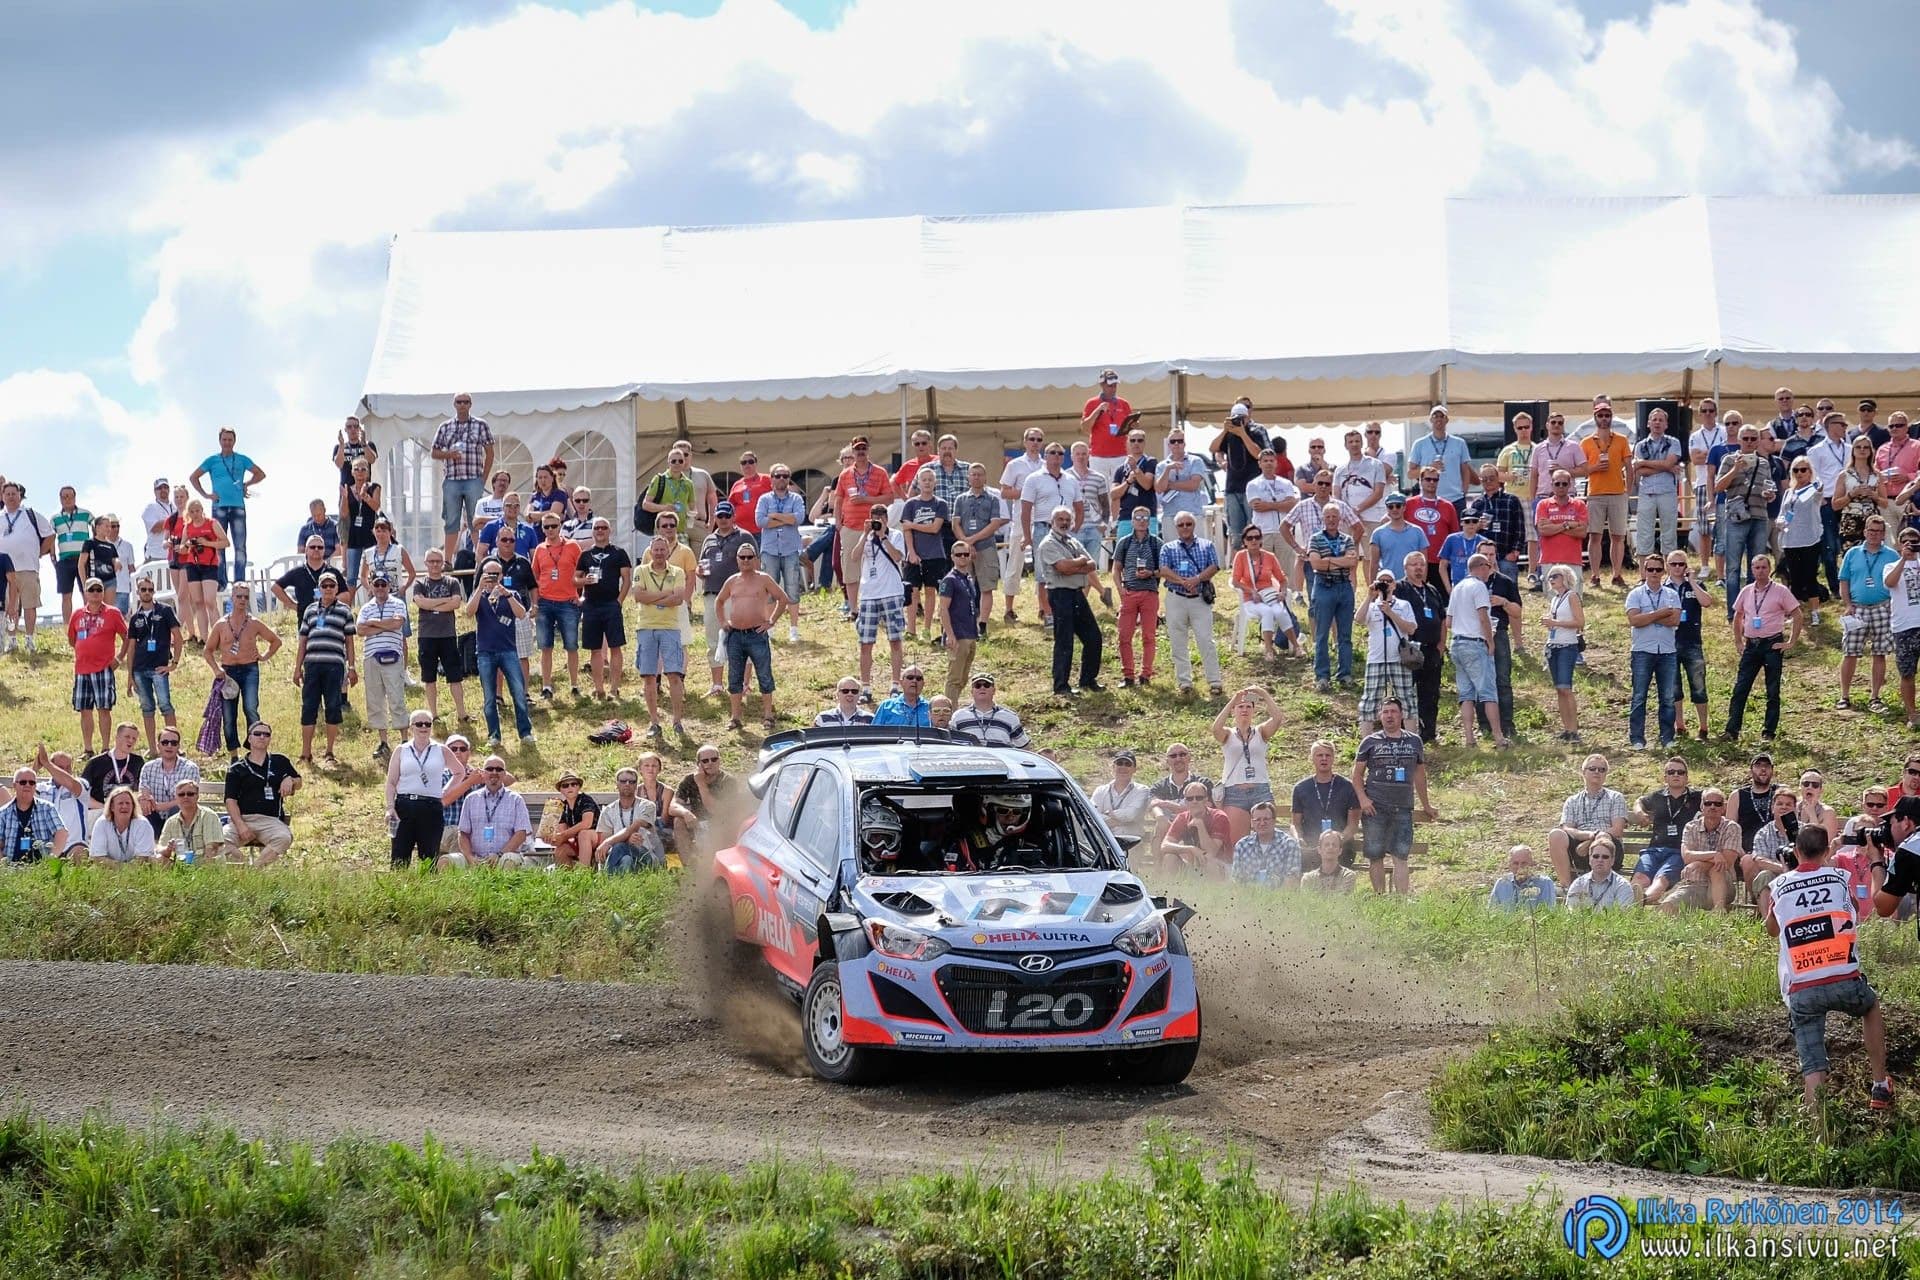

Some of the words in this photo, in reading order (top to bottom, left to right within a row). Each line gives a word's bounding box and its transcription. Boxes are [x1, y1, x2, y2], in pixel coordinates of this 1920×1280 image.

[1795, 888, 1833, 908] 422
[757, 906, 796, 958] HELIX
[989, 931, 1040, 943] HELIX
[1042, 933, 1091, 943] ULTRA
[1788, 922, 1827, 939] Lexar
[1807, 946, 1830, 957] AUGUST
[1151, 958, 1168, 975] HELIX
[1795, 955, 1824, 970] 2014
[885, 964, 917, 982] HELIX
[905, 1033, 943, 1041] MICHELIN
[1135, 1028, 1160, 1037] MICHELIN
